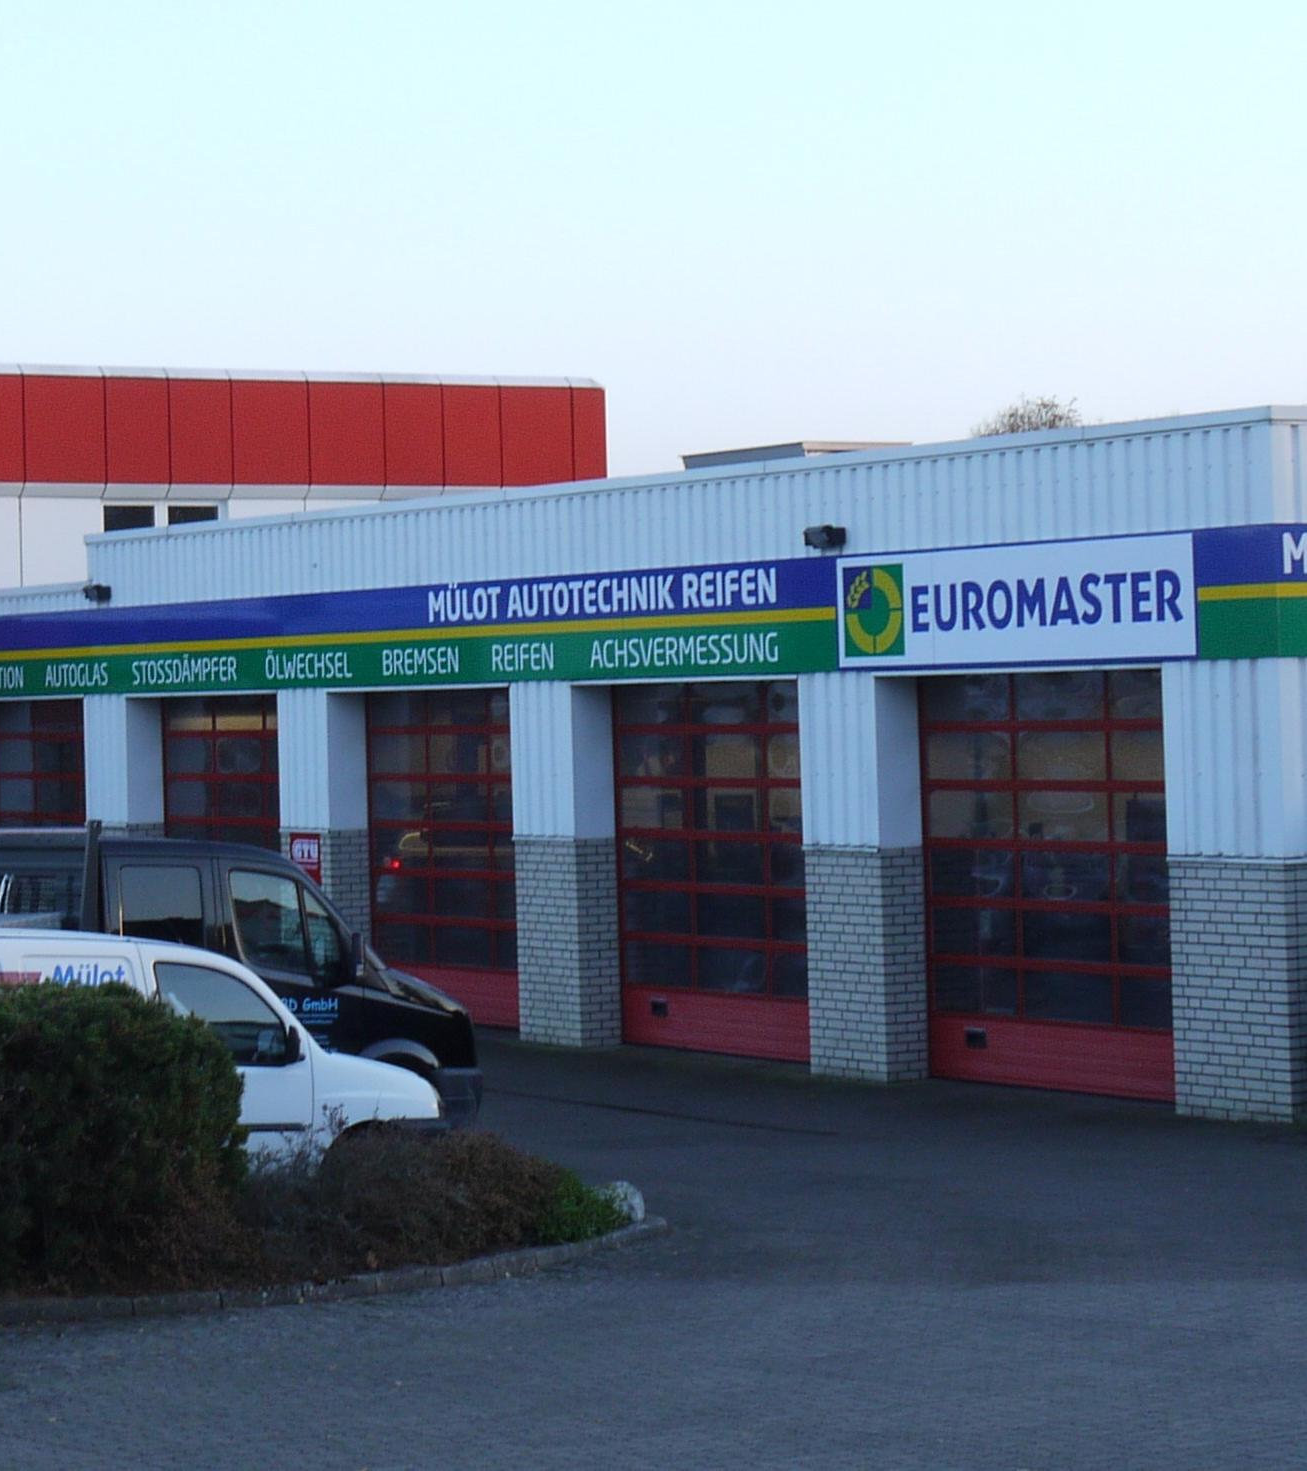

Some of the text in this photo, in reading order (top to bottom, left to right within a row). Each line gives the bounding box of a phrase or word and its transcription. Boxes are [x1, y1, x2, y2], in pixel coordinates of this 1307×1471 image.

[428, 567, 777, 623] MÜLOT AUTOTECHNIK REIFEN
[911, 569, 1183, 633] EUROMASTER
[45, 662, 108, 688] AUTOGLAS
[132, 653, 237, 685] STOSSDÄMPFER
[265, 649, 352, 680] ÖLWECHSEL
[382, 646, 459, 676] BREMSEN
[492, 642, 554, 672] REIFEN
[590, 631, 778, 669] ACHSVERMESSUNG
[303, 997, 338, 1012] GmbH
